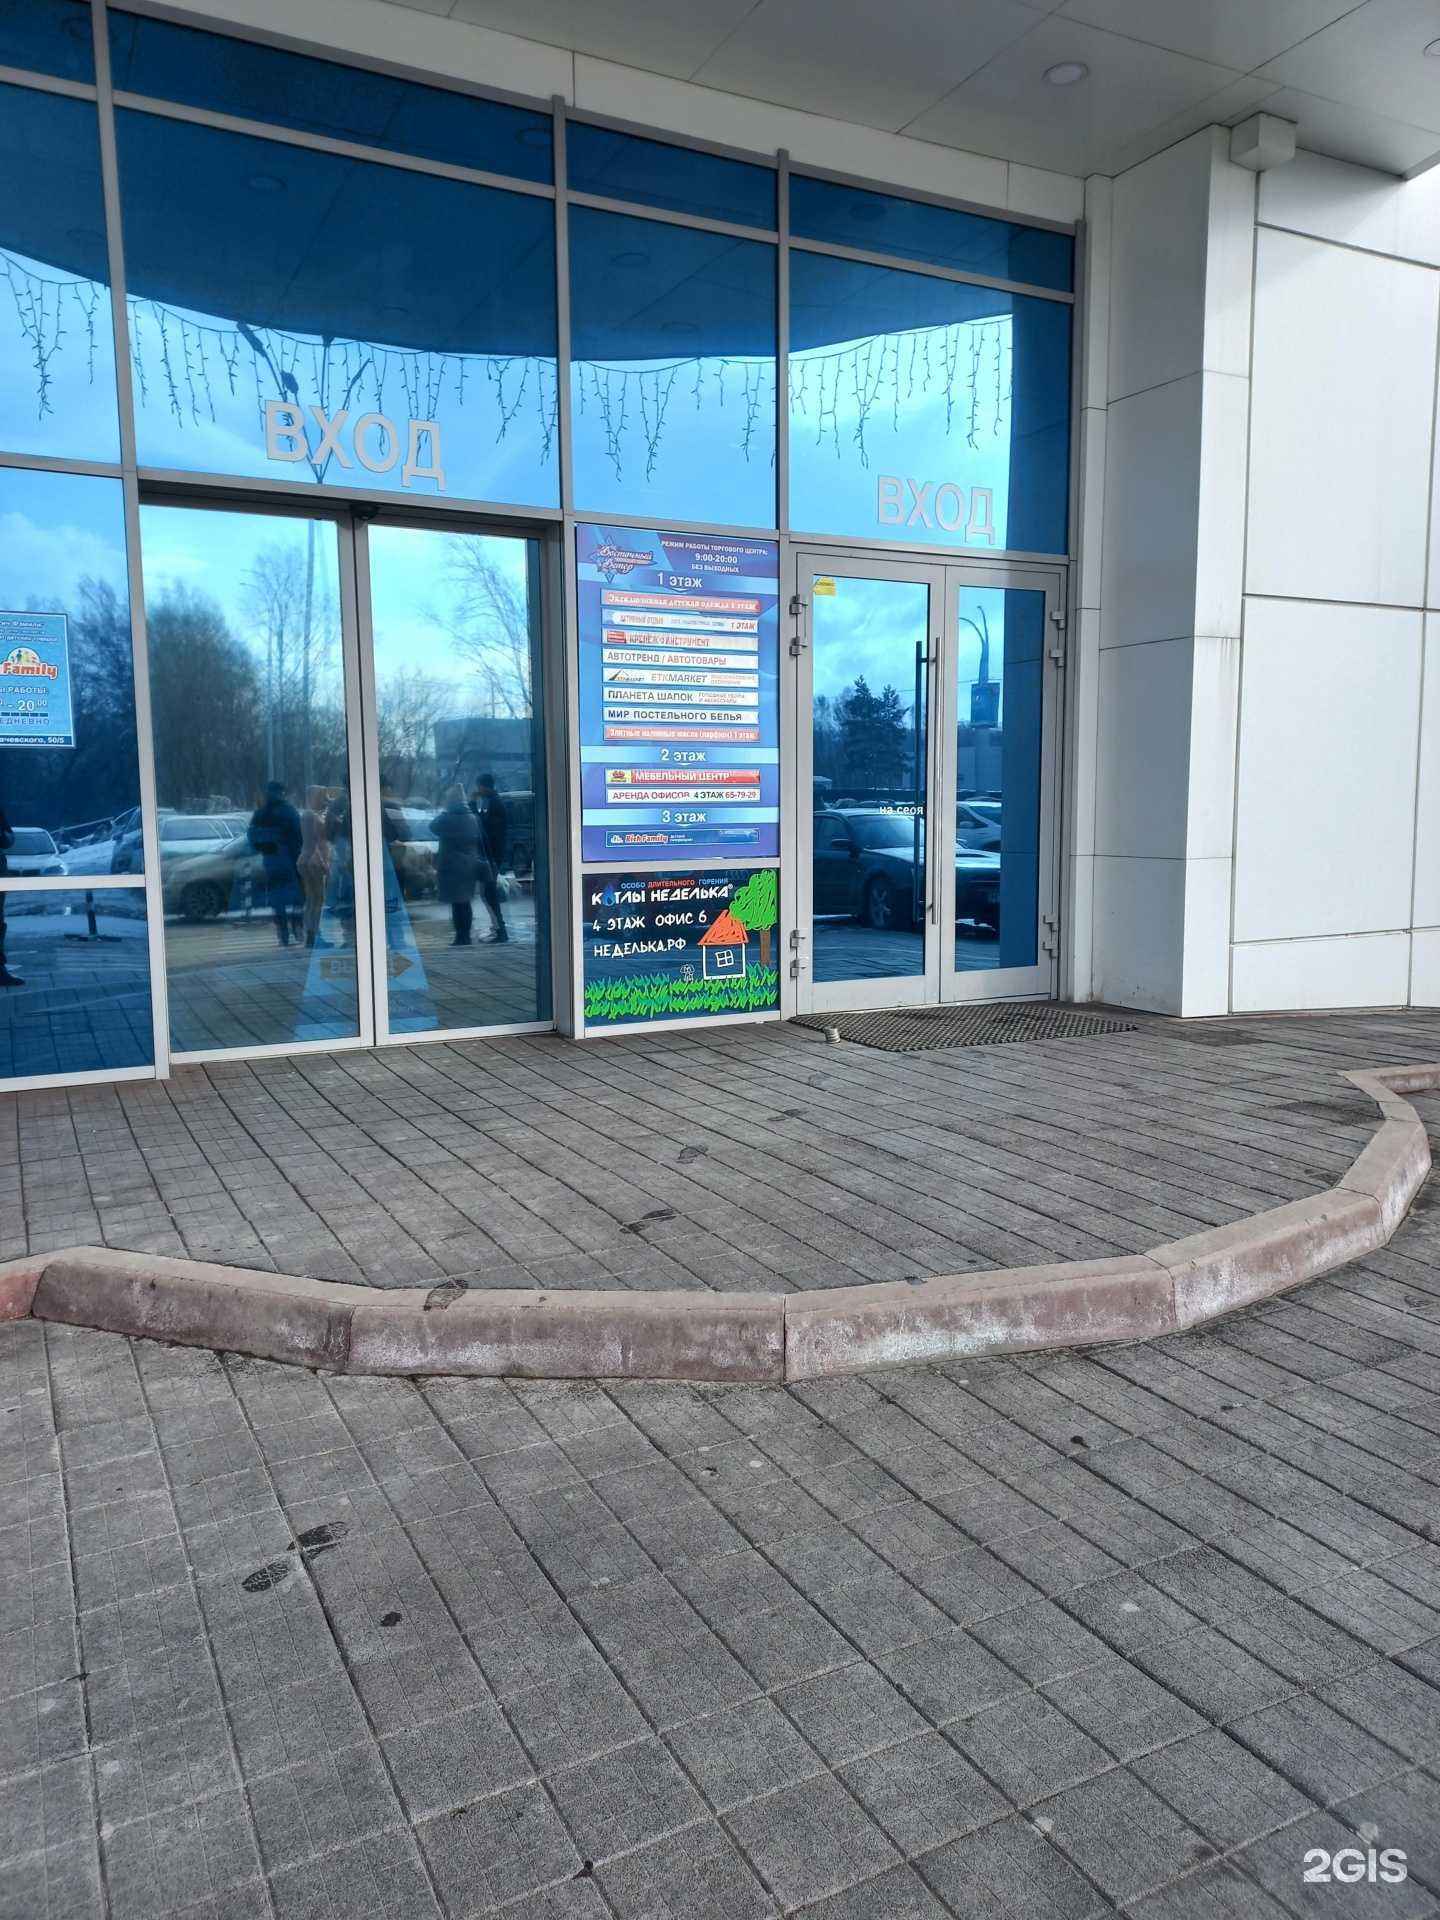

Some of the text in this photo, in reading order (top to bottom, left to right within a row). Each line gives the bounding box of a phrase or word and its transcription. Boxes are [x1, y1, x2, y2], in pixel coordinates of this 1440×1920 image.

[265, 400, 447, 491] ВХОД
[877, 476, 995, 545] ВХОД
[661, 541, 685, 549] РЕЖИМ
[711, 545, 744, 553] ТОРГОВОГО
[695, 553, 738, 563] 9:00-20:00
[704, 565, 739, 573] ВЫХОДНЫХ
[658, 572, 703, 588] 1 этаж
[608, 652, 660, 662] АВТОТРЕНД
[668, 656, 727, 665] АВТОТОВАРЫ
[3, 662, 58, 680] Family
[608, 691, 693, 702] ПЛАНЕТА ШАПОК
[17, 699, 35, 711] 20
[608, 710, 742, 721] МИР ПОСТЕЛЬНОГО БЕЛЬЯ
[47, 736, 65, 744] 50/5
[661, 749, 706, 761] 2 этаж
[612, 792, 649, 800] АРЕНДА
[700, 791, 724, 799] ЭТАЖ
[662, 810, 706, 823] 3 этаж
[642, 834, 669, 844] Family
[648, 879, 695, 888] ДЛИТЕЛЬНОГО
[592, 910, 707, 931] 4 ЭТАЖ ОФИС 6
[594, 937, 686, 958] НЕДЕЛЬКА.РФ
